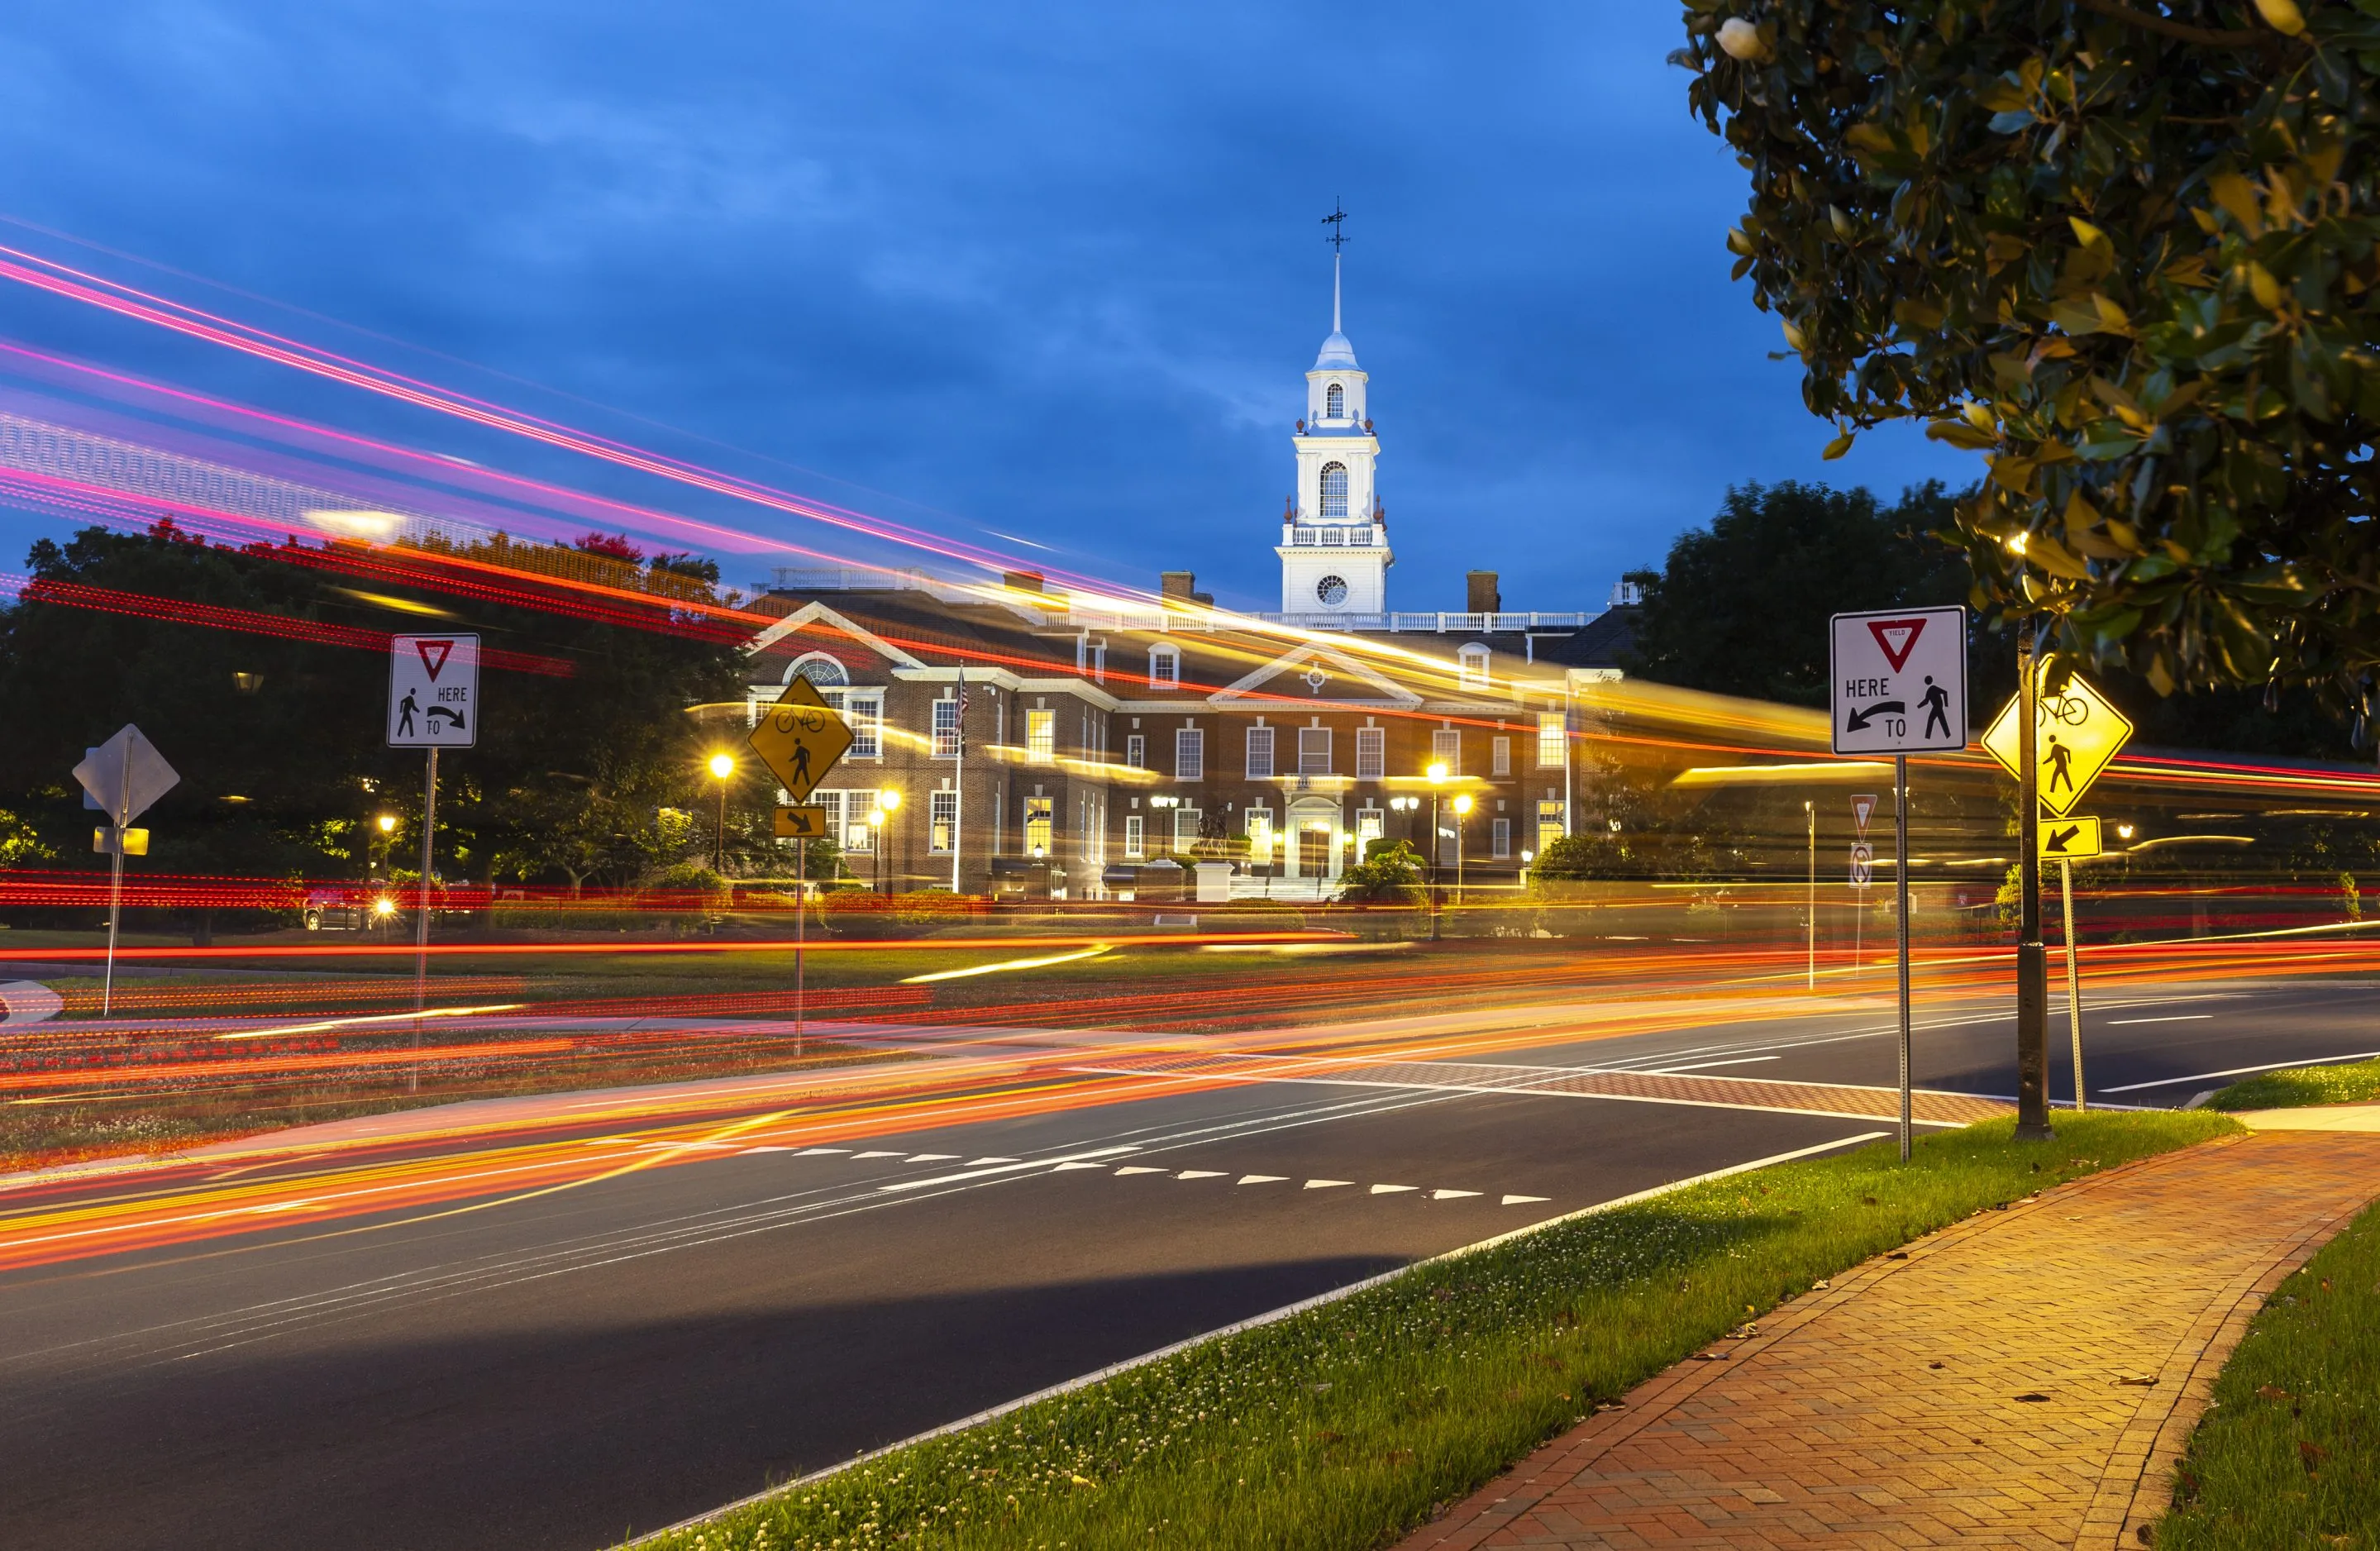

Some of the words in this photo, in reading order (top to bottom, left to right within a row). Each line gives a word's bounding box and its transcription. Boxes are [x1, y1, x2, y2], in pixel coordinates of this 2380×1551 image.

[438, 687, 467, 702] HERE
[1846, 678, 1890, 698] HERE
[427, 720, 440, 735] TO
[1885, 719, 1906, 737] TO
